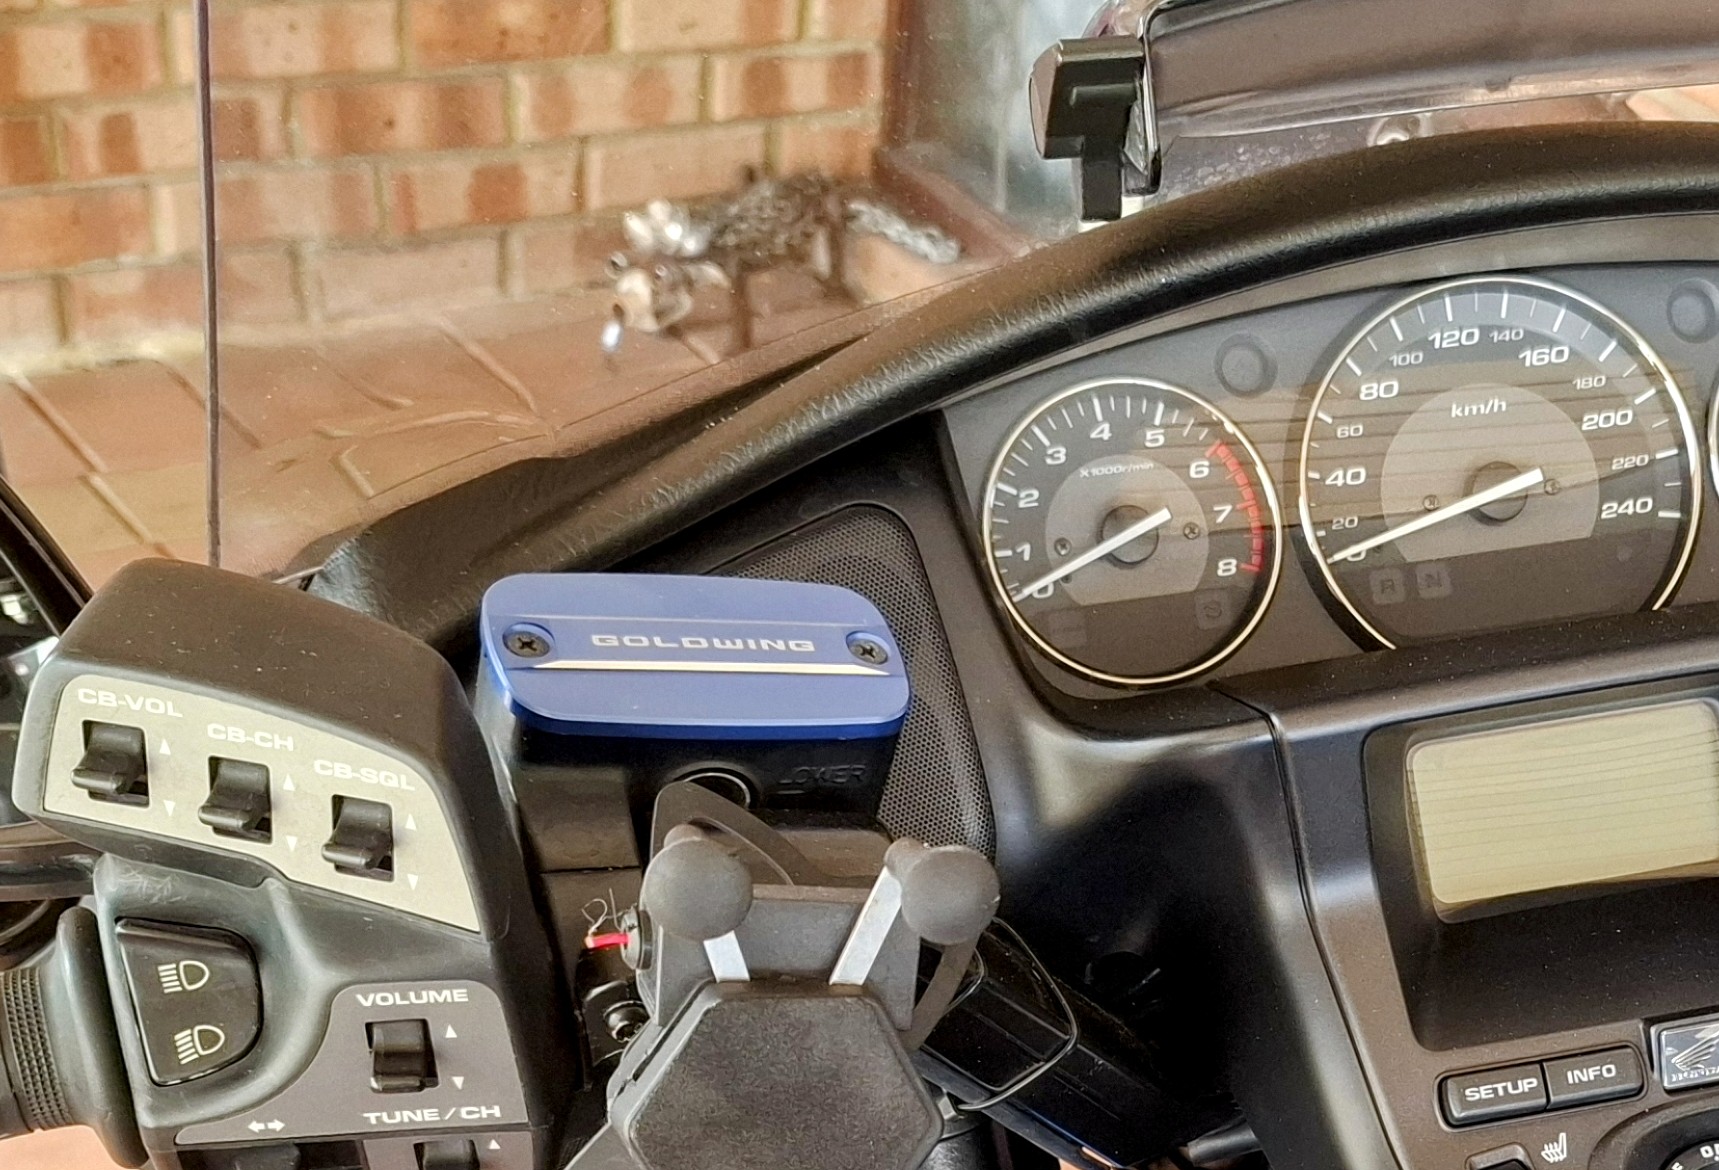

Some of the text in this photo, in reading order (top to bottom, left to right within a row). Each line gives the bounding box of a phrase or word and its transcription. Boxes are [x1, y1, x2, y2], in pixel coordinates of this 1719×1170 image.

[1428, 328, 1480, 349] 120
[1489, 328, 1524, 343] 140
[1389, 351, 1423, 368] 100
[1518, 346, 1569, 367] 160
[1359, 380, 1399, 401] 80
[1572, 374, 1607, 391] 180
[1450, 399, 1507, 418] km/h
[1581, 410, 1633, 431] 200
[1090, 422, 1112, 441] 4
[1144, 430, 1165, 448] 5
[1336, 424, 1363, 439] 60
[1045, 447, 1067, 465] 3
[1611, 454, 1650, 470] 220
[1189, 461, 1210, 478] 6
[1324, 467, 1367, 486] 40
[1018, 489, 1040, 508] 2
[1213, 505, 1232, 523] 7
[1601, 497, 1654, 519] 240
[1331, 515, 1359, 530] 20
[1015, 543, 1031, 561] 1
[1217, 558, 1237, 576] 8
[591, 634, 816, 652] GOLDWING
[77, 688, 183, 717] CB-VOL
[207, 724, 294, 752] CB-CH
[313, 760, 415, 792] CB-SQL
[356, 989, 469, 1007] VOLUME
[1464, 1063, 1617, 1102] SETUP INFO
